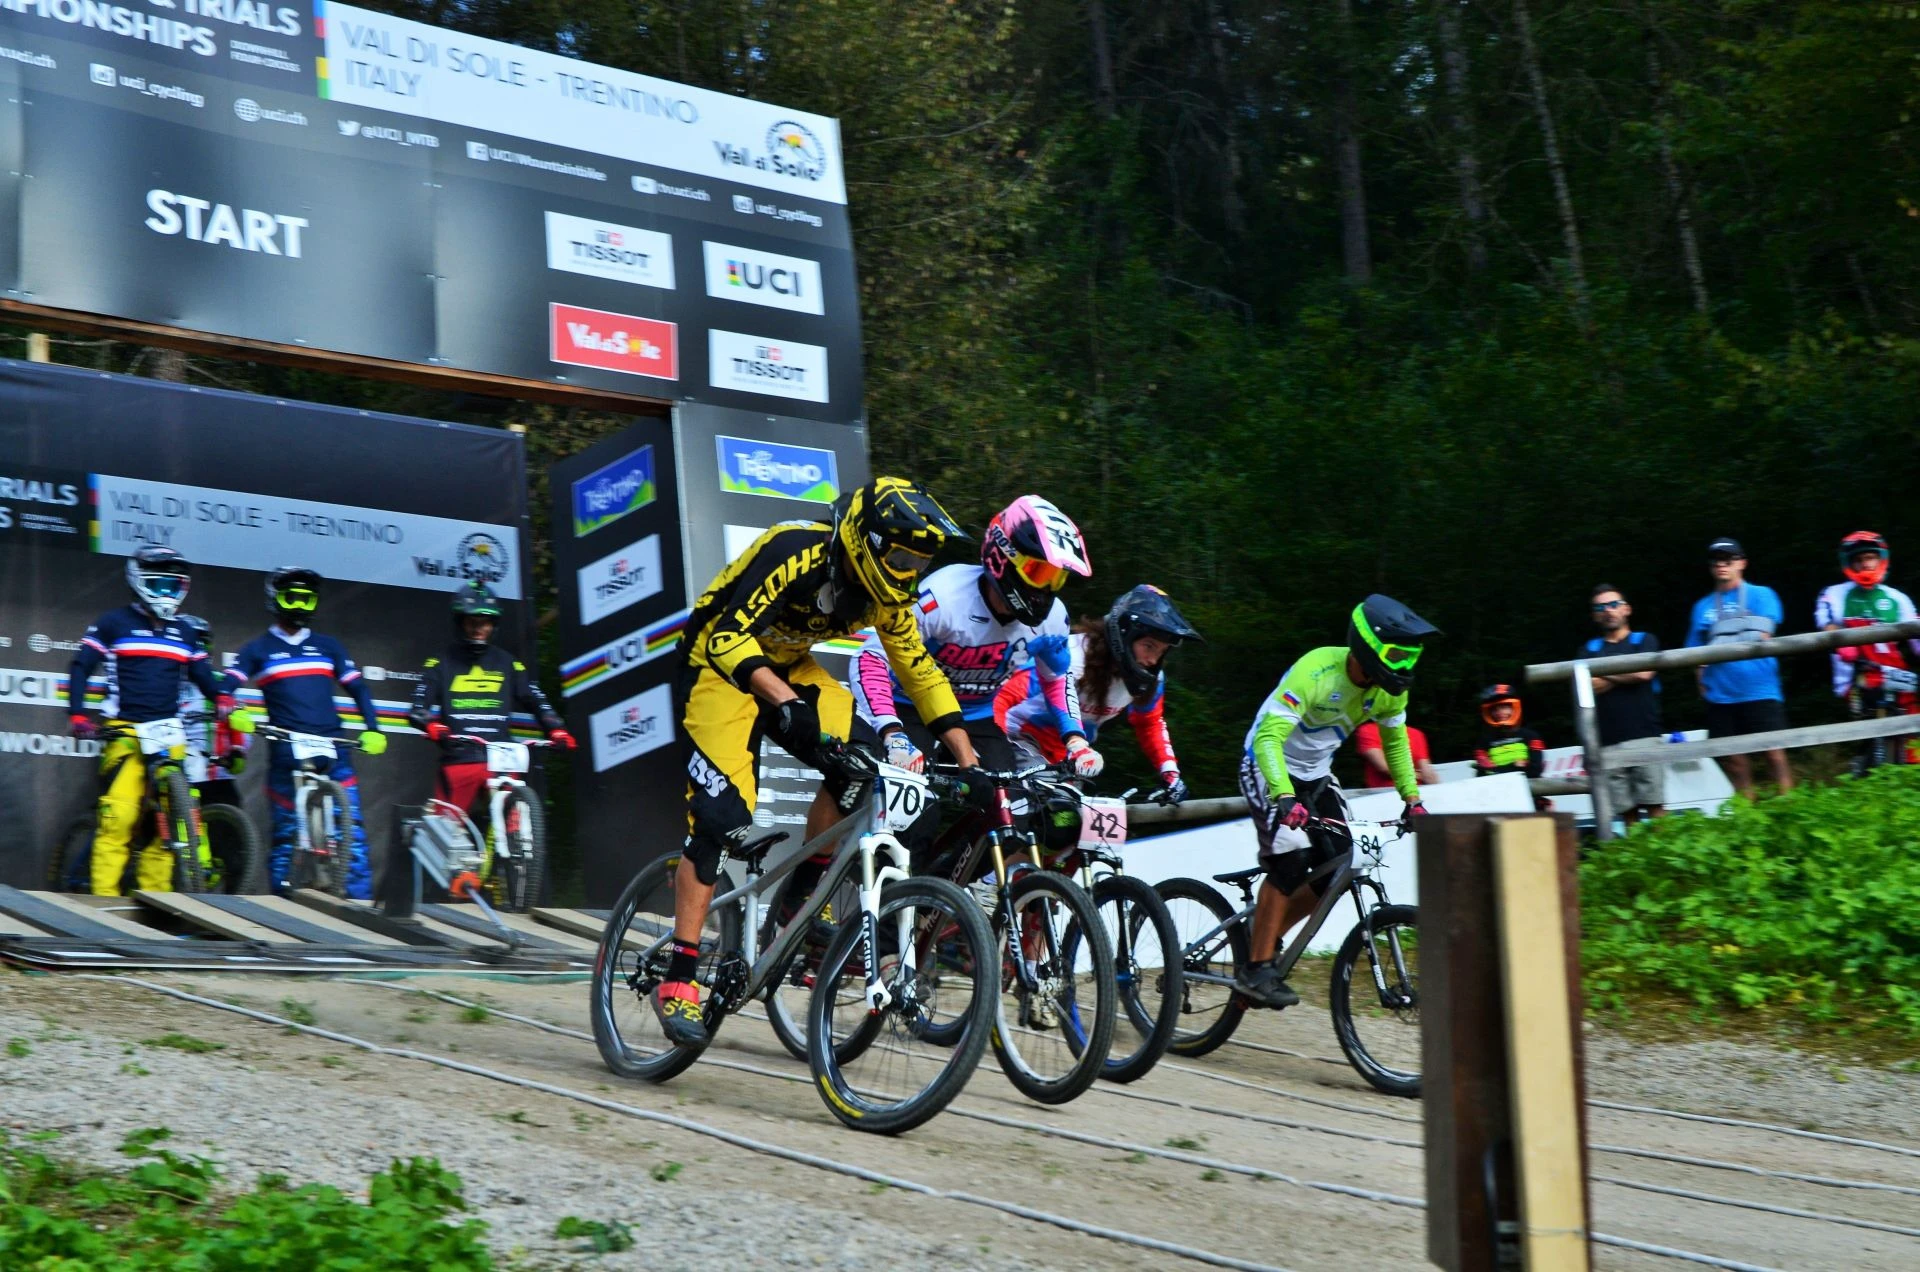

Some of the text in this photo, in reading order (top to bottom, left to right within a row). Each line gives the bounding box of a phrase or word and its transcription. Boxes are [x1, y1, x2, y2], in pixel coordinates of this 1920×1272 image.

[340, 20, 399, 58] VAL
[406, 36, 439, 68] DI
[446, 47, 528, 87] SOLE
[554, 71, 699, 124] TRENTINO
[345, 58, 422, 98] ITALY
[711, 140, 748, 166] Val
[772, 154, 818, 181] Sole
[145, 188, 309, 258] START
[569, 240, 651, 269] TISSOT
[741, 261, 803, 297] UCI
[730, 357, 808, 383] TISSOT
[108, 490, 157, 516] VAL
[162, 497, 189, 520] DI
[195, 501, 262, 528] SOLE
[284, 511, 404, 545] TRENTINO
[111, 519, 175, 546] ITALY
[991, 525, 1018, 558] 100%
[593, 566, 646, 600] TISSOT
[734, 541, 826, 632] GHOST
[607, 637, 643, 668] UCI
[936, 641, 1009, 669] RACE
[0, 731, 99, 757] WORLD
[605, 716, 657, 747] TISSOT
[889, 780, 921, 816] 70
[1090, 812, 1119, 839] 42
[1360, 834, 1382, 855] 84
[862, 915, 873, 981] MAGURA
